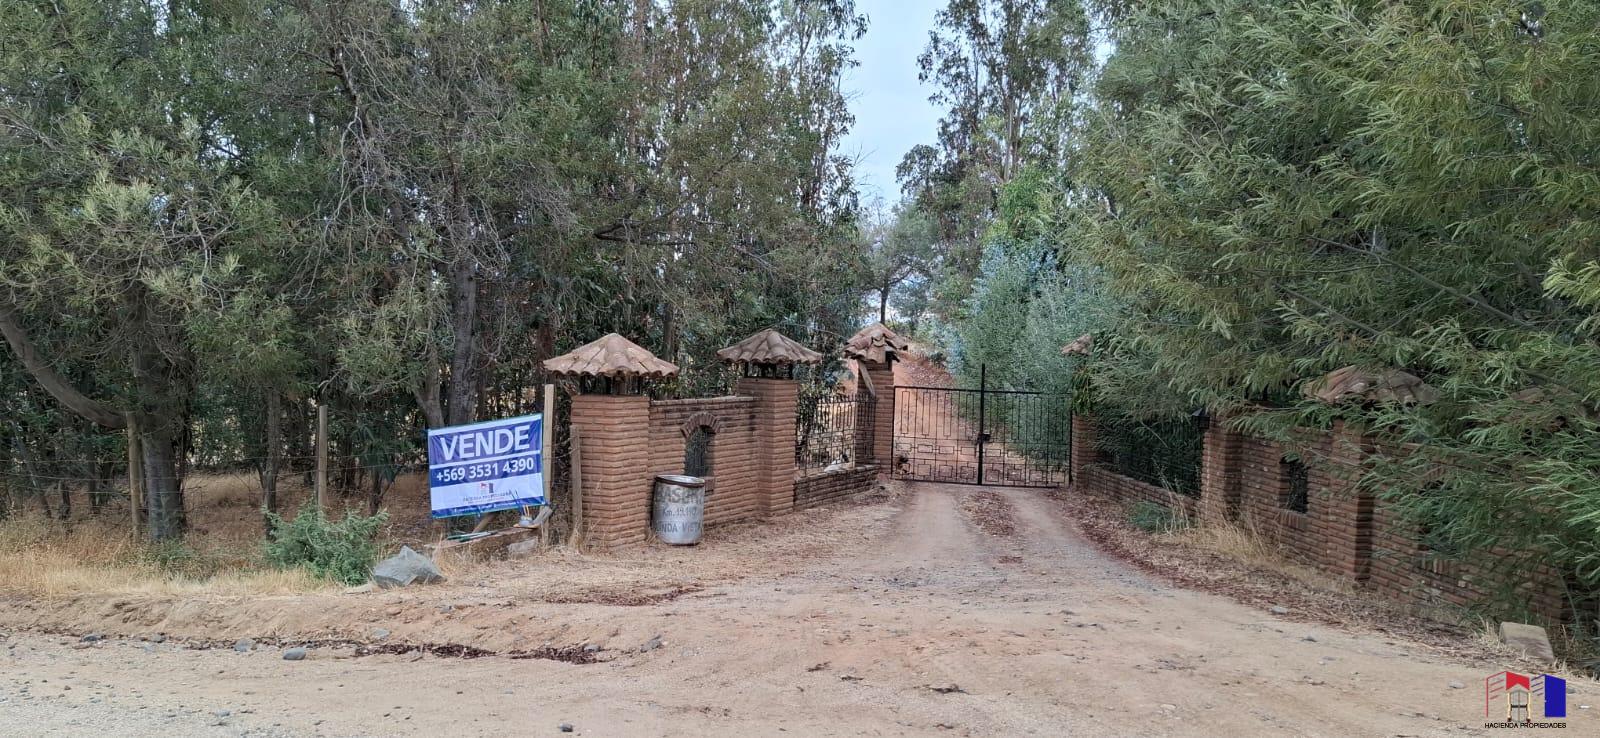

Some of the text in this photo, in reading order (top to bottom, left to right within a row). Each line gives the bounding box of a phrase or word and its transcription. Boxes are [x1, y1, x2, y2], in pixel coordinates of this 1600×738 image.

[440, 424, 530, 461] VENDE
[436, 457, 534, 482] +569 3531 4390
